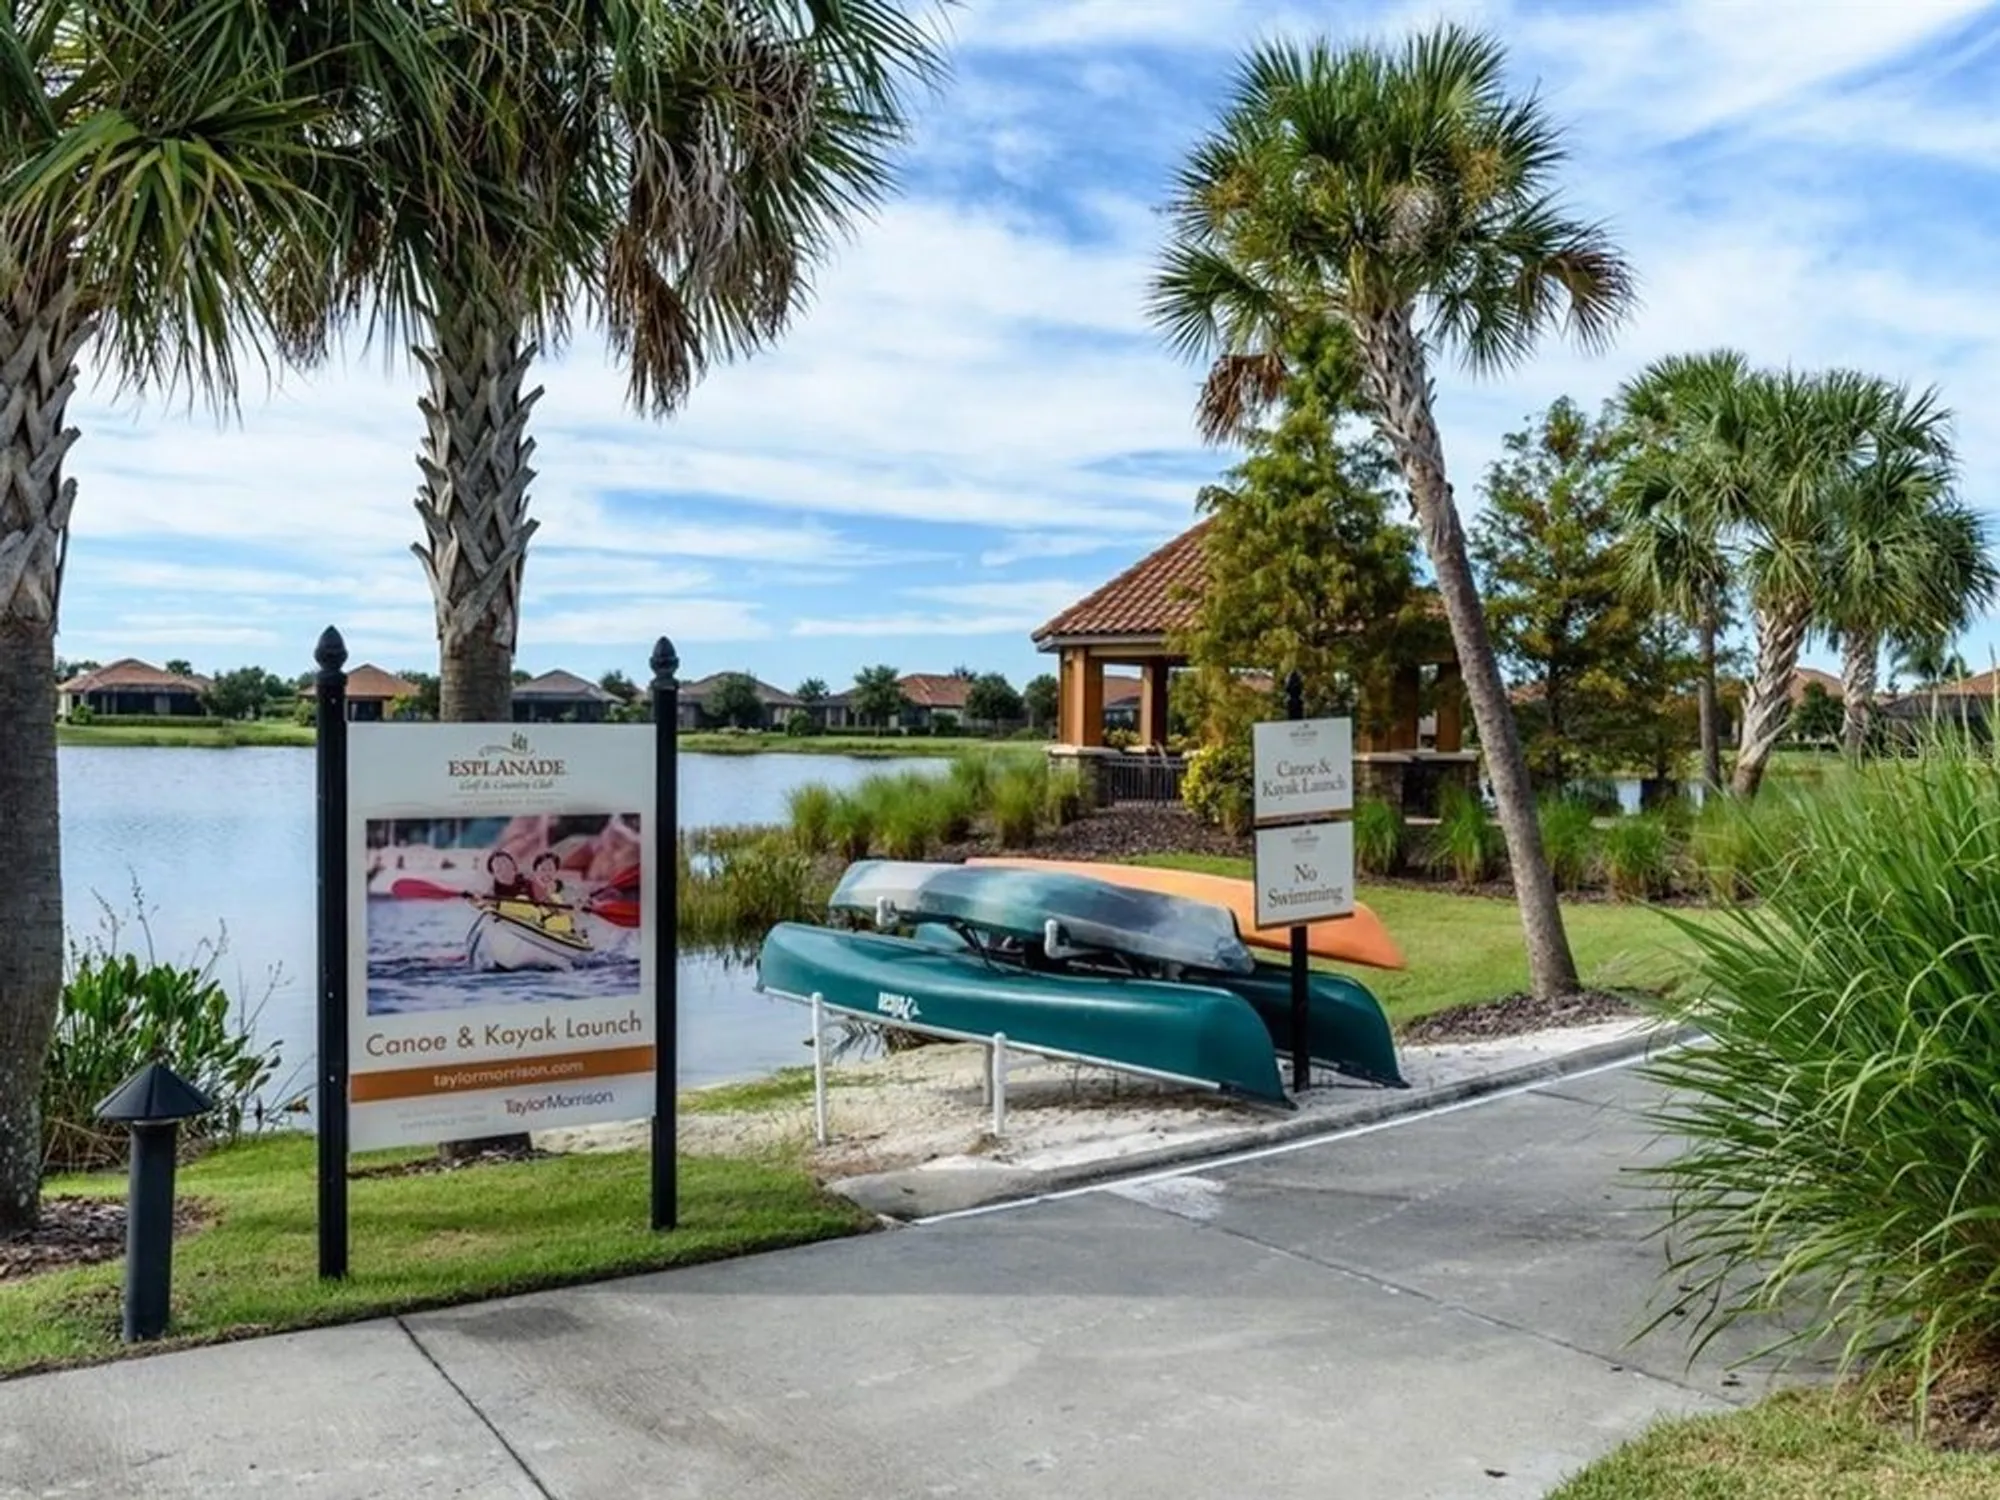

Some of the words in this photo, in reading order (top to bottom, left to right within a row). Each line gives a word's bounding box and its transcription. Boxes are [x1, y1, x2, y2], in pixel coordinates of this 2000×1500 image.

[448, 759, 566, 777] ESPLANADE
[1277, 760, 1315, 777] Canoe
[1319, 758, 1332, 774] &
[1302, 774, 1347, 795] Launch
[1294, 864, 1318, 883] No
[1267, 883, 1343, 909] Swimming
[366, 1033, 447, 1057] Canoe
[457, 1026, 475, 1049] &
[485, 1016, 556, 1049] Kayak
[566, 1010, 642, 1038] Launch
[433, 1061, 585, 1088] taylormorrison.com
[504, 1091, 614, 1116] TaylorMorrison
